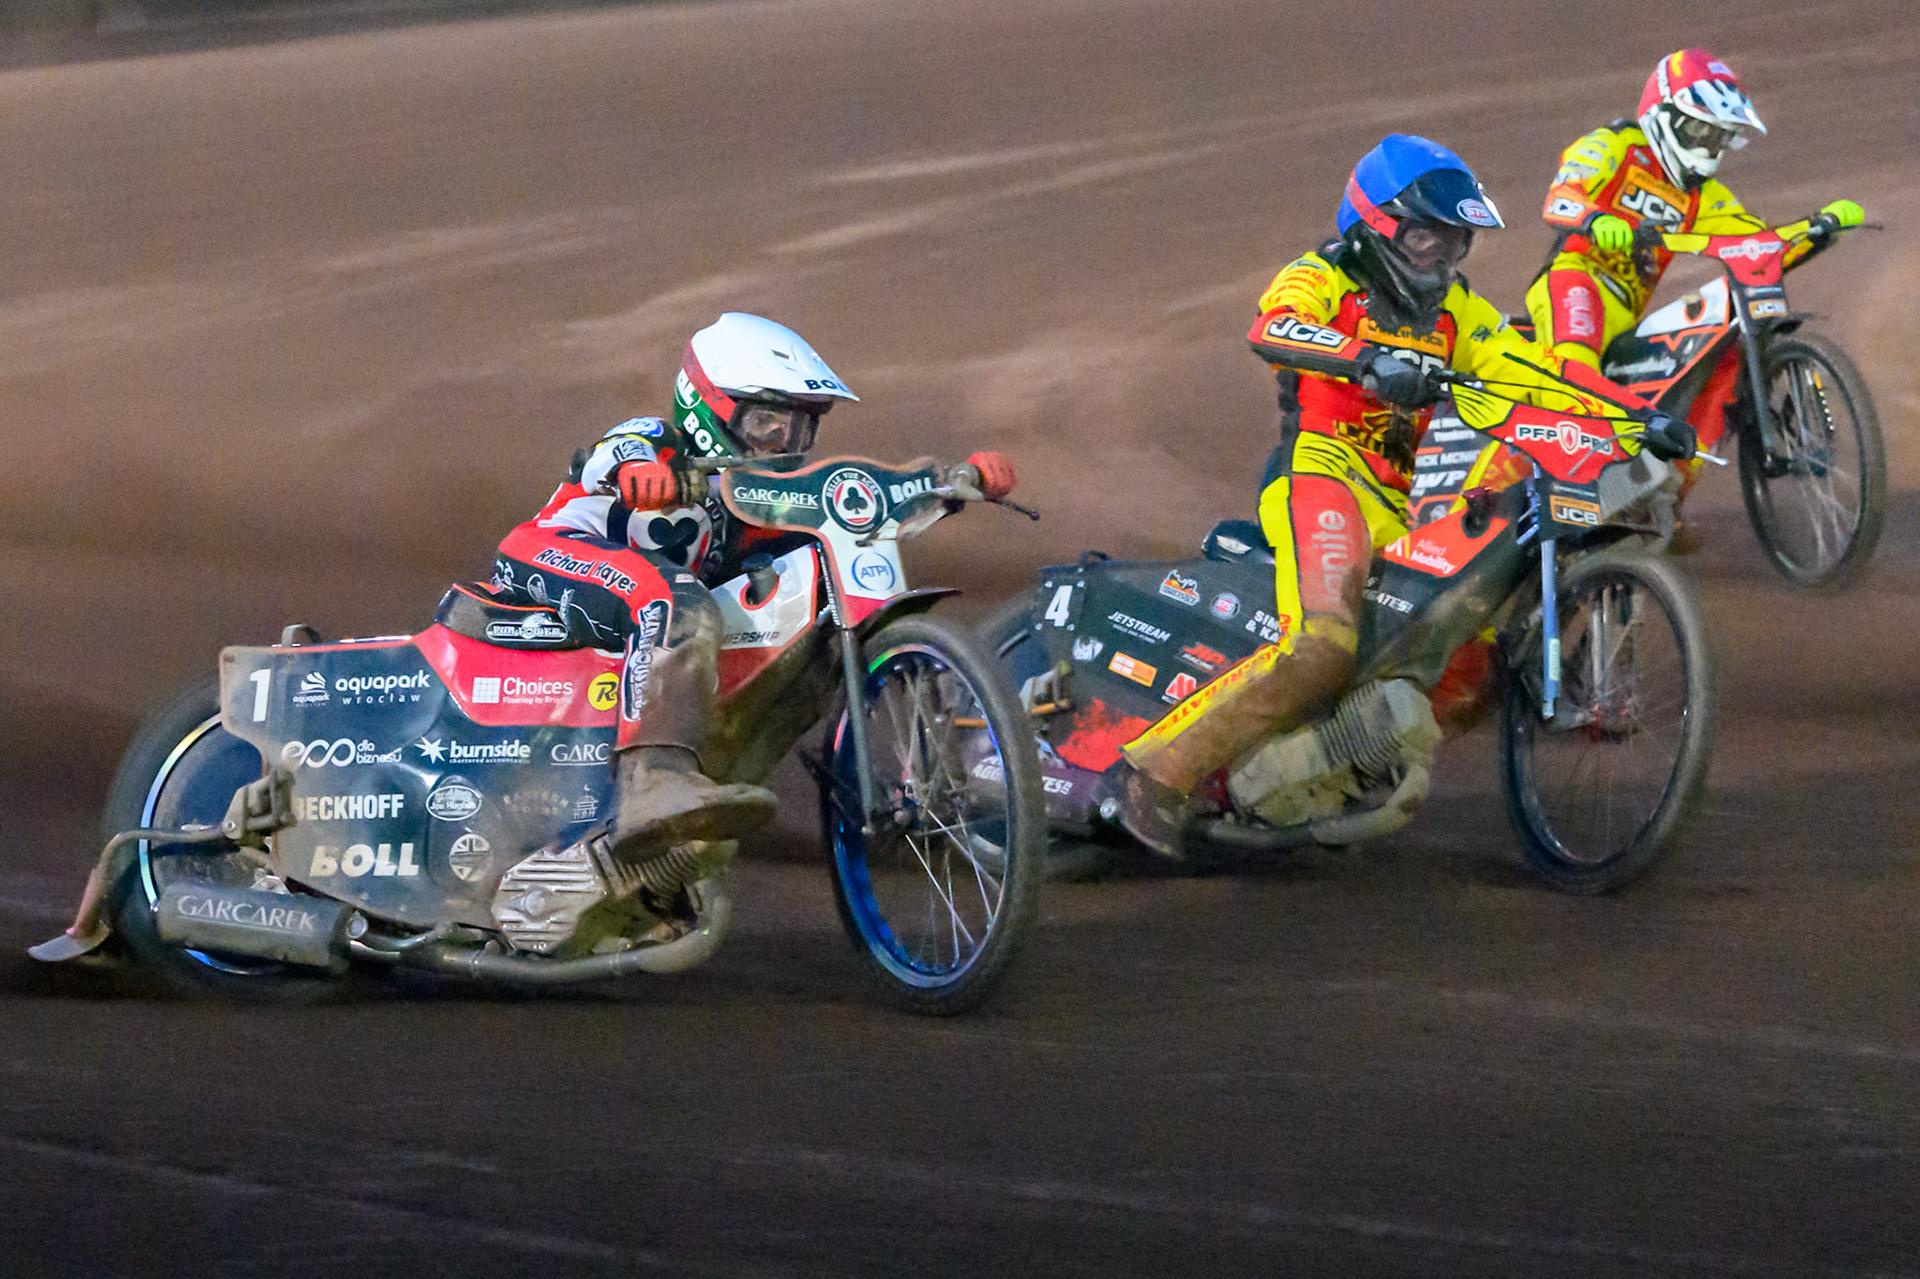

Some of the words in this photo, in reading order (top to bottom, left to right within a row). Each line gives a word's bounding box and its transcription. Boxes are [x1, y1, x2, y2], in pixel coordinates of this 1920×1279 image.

[1268, 318, 1346, 347] JCB
[1518, 426, 1558, 440] PFP
[842, 472, 859, 480] VUE
[733, 486, 819, 507] GARCAREK
[1556, 508, 1599, 526] JCB
[533, 547, 596, 577] Richard
[860, 562, 889, 579] ATPI
[1410, 549, 1456, 575] Mobility
[1044, 585, 1073, 627] 4
[1107, 611, 1171, 642] JETSTREAM
[335, 669, 430, 695] aquapark
[503, 677, 573, 696] Choices
[249, 668, 272, 723] 1
[281, 737, 356, 769] eco
[356, 739, 375, 751] dla
[450, 739, 531, 759] burnside
[356, 752, 402, 765] biznesu
[309, 842, 420, 877] BOLL
[176, 894, 320, 932] GARCAREK
